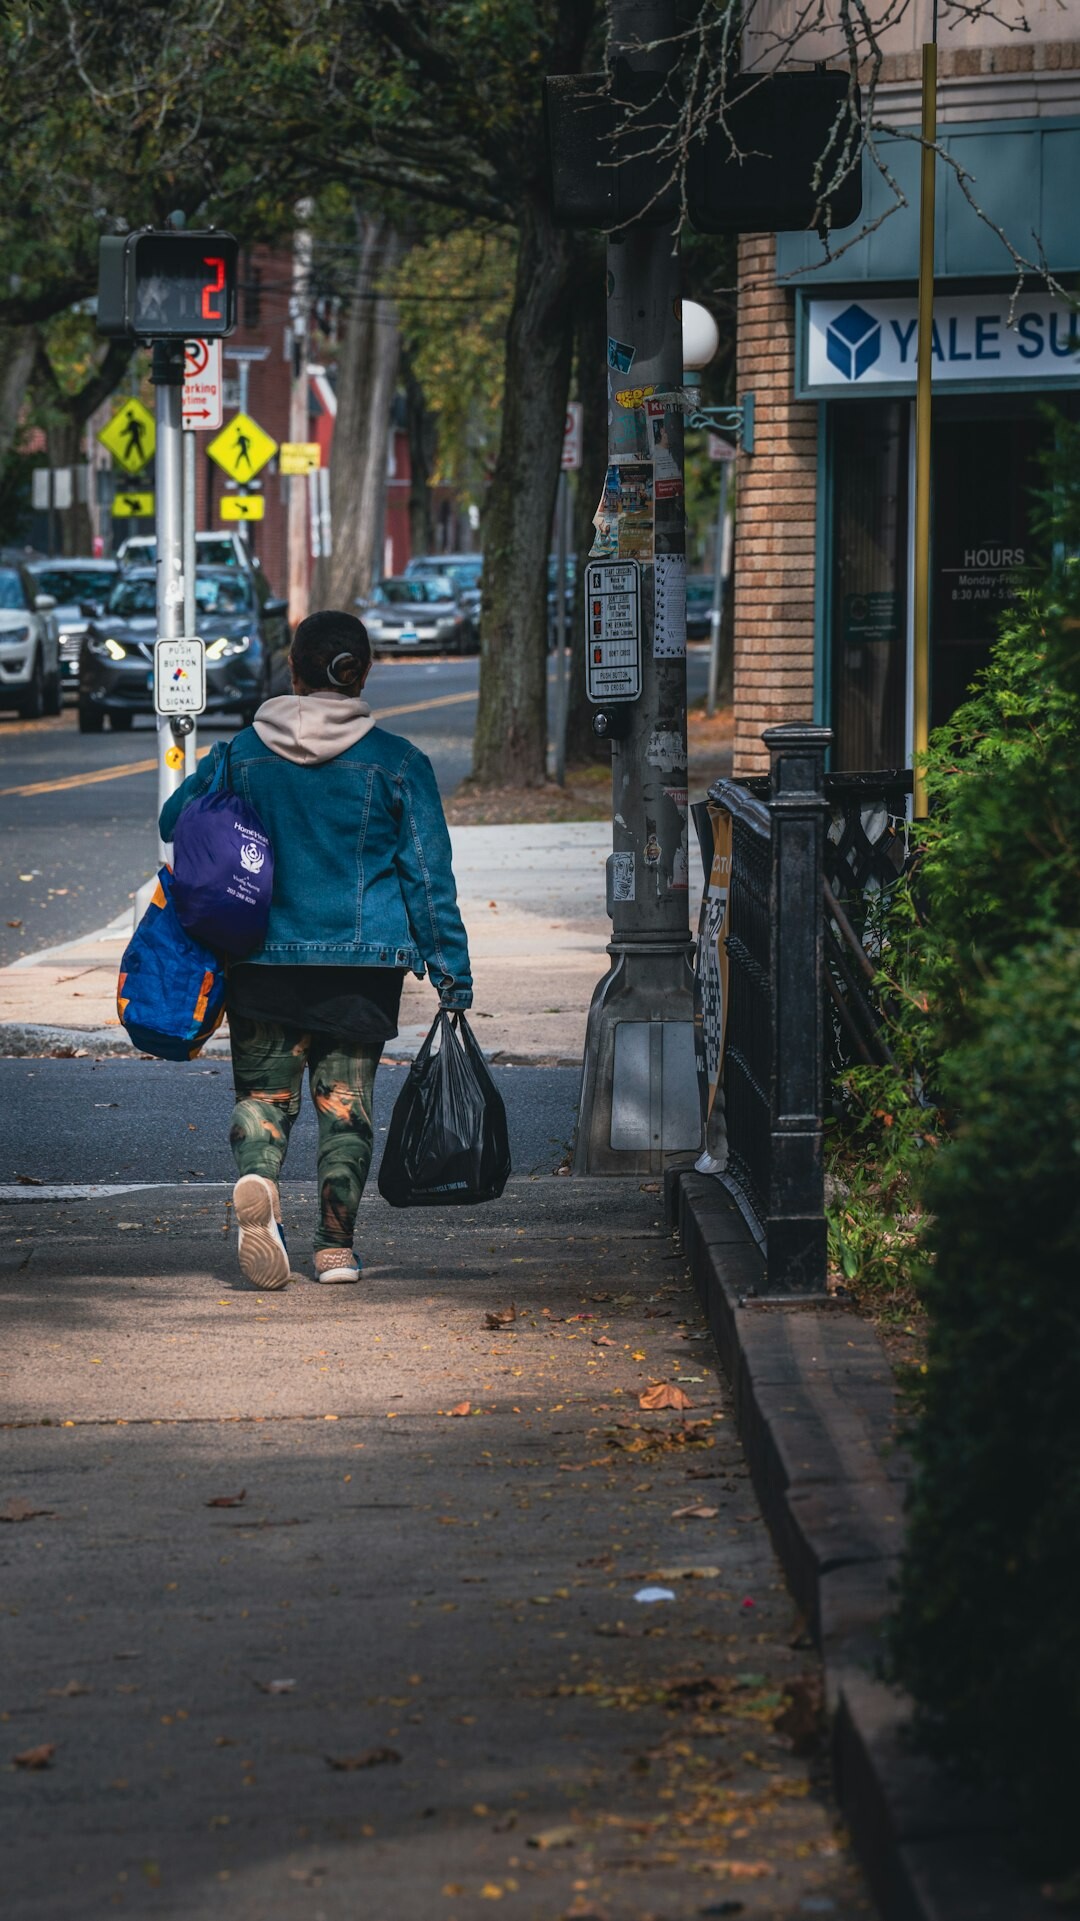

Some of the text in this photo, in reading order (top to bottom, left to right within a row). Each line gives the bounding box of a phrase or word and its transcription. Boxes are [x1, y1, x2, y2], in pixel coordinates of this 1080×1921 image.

[202, 257, 225, 320] 2
[890, 315, 1001, 363] YALE
[183, 383, 216, 396] arking
[964, 548, 1025, 567] HOURS
[952, 589, 972, 600] 8:30
[974, 589, 990, 600] AM
[166, 698, 196, 706] SIGNAL
